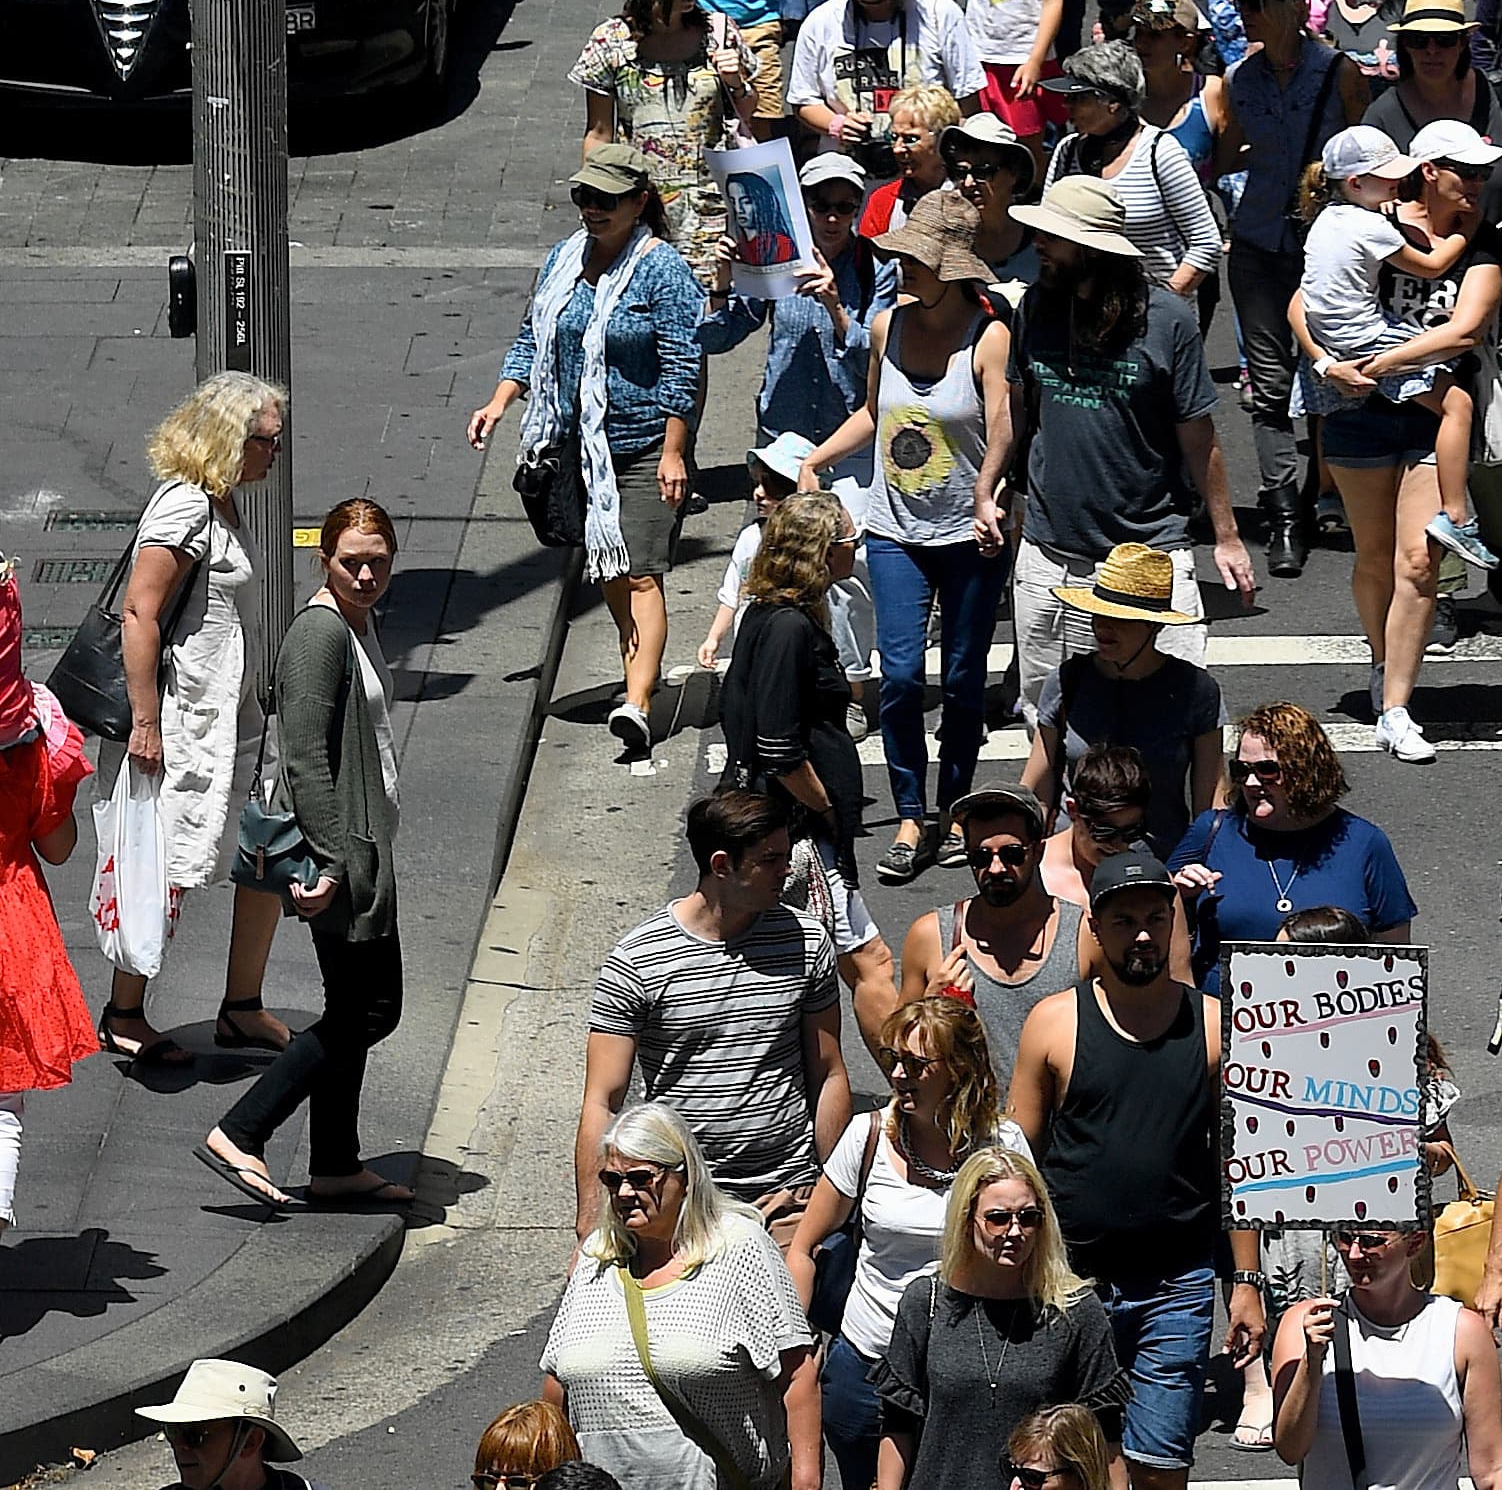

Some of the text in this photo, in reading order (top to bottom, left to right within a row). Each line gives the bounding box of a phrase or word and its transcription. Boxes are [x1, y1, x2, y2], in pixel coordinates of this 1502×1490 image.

[1232, 974, 1426, 1034] OUR BODIES
[1224, 1061, 1421, 1116] OUR MINDS
[1226, 1127, 1420, 1184] OUR POWER
